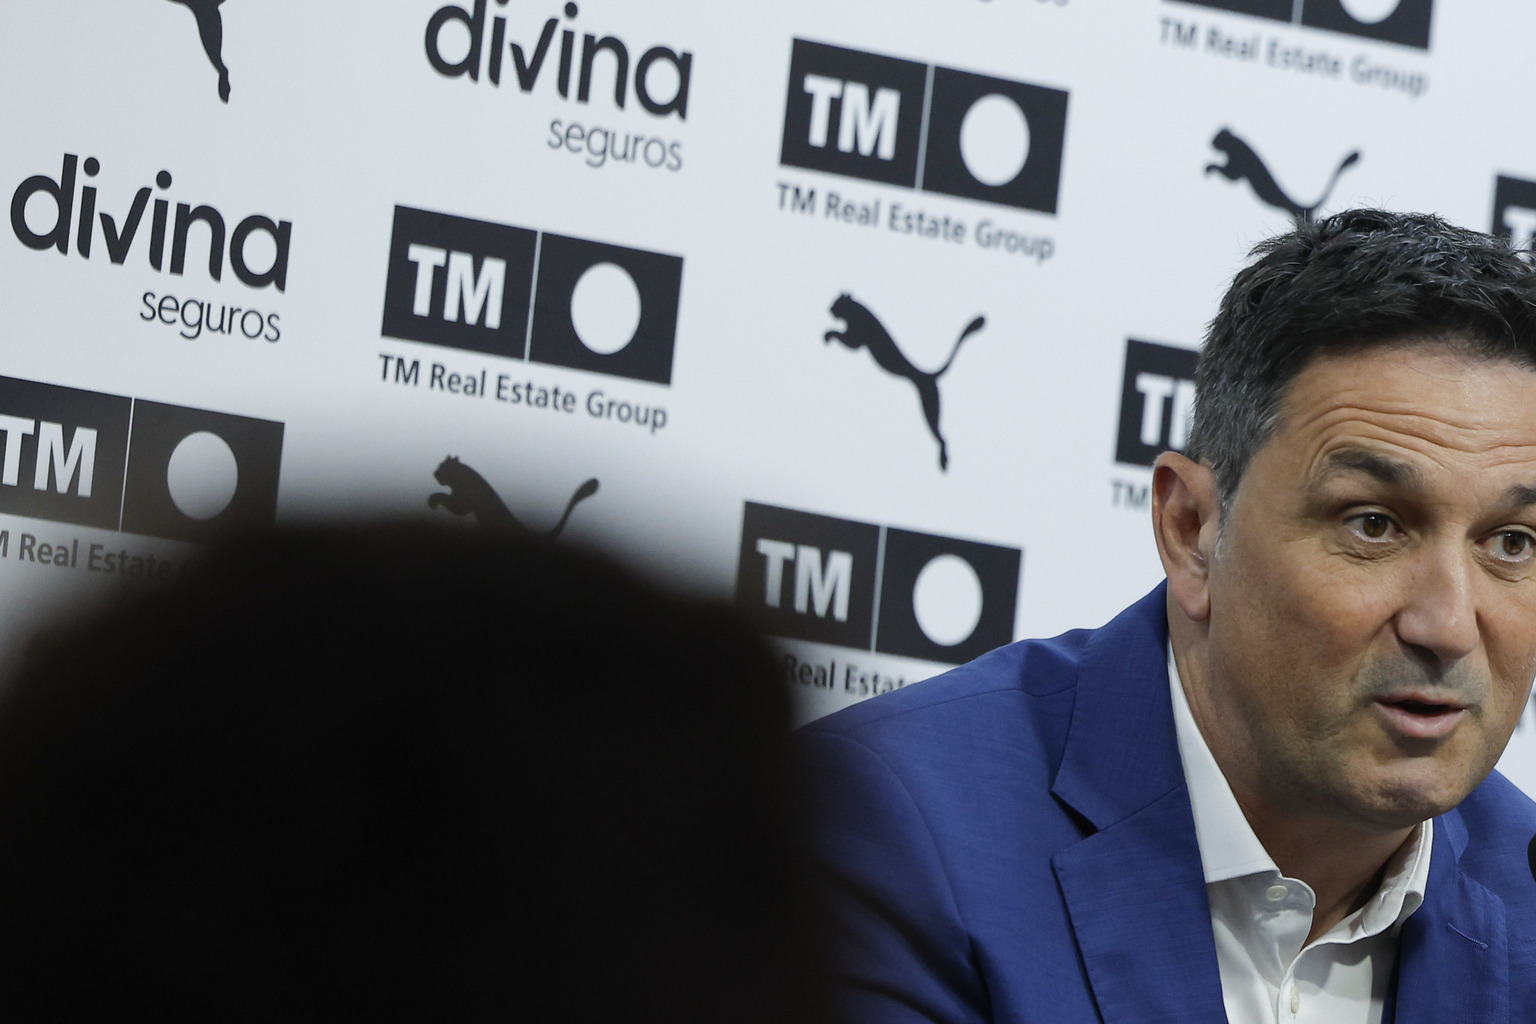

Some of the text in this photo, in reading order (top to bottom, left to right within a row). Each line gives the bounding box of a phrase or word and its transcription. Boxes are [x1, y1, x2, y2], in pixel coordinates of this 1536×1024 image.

[1159, 17, 1429, 99] TM Real Estate Group
[547, 118, 683, 172] seguros
[802, 73, 901, 162] TM
[10, 153, 292, 292] divina
[775, 181, 1057, 266] TM Real Estate Group
[138, 290, 281, 343] seguros
[407, 243, 507, 330] TM
[379, 353, 668, 435] TM Real Estate Group
[0, 414, 97, 498] TM
[1111, 479, 1149, 510] TM
[19, 533, 78, 568] Real
[88, 543, 172, 579] Estate
[756, 537, 853, 623] TM
